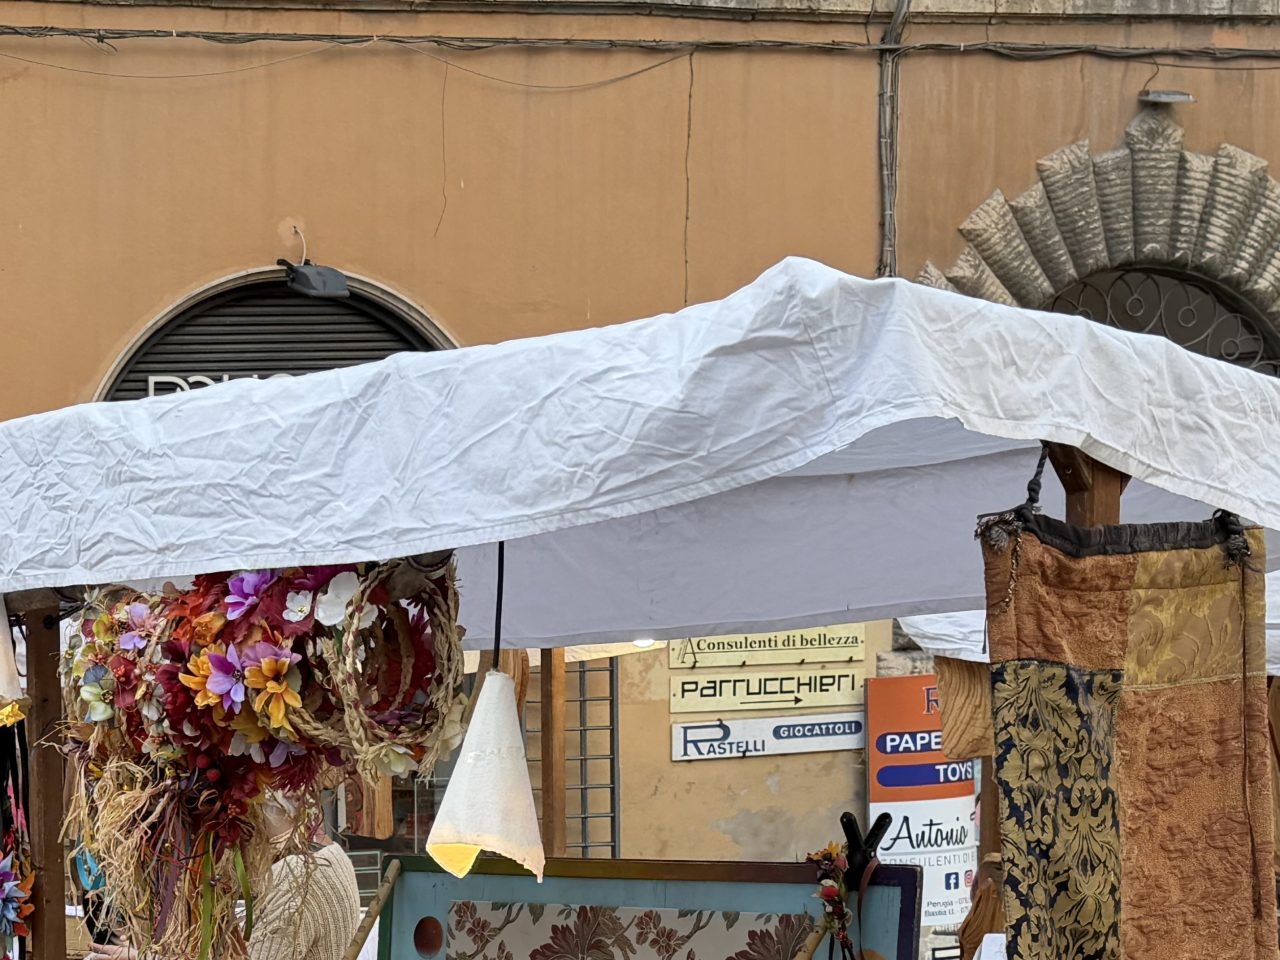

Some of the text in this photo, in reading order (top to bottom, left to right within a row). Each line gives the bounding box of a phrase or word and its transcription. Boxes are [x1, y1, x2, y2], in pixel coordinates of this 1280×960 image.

[696, 632, 859, 651] Consulenti di bellezza
[779, 722, 856, 738] GIOCATTOLI
[886, 731, 943, 753] PAPE
[935, 761, 973, 783] TOYS
[880, 815, 968, 852] Antonio
